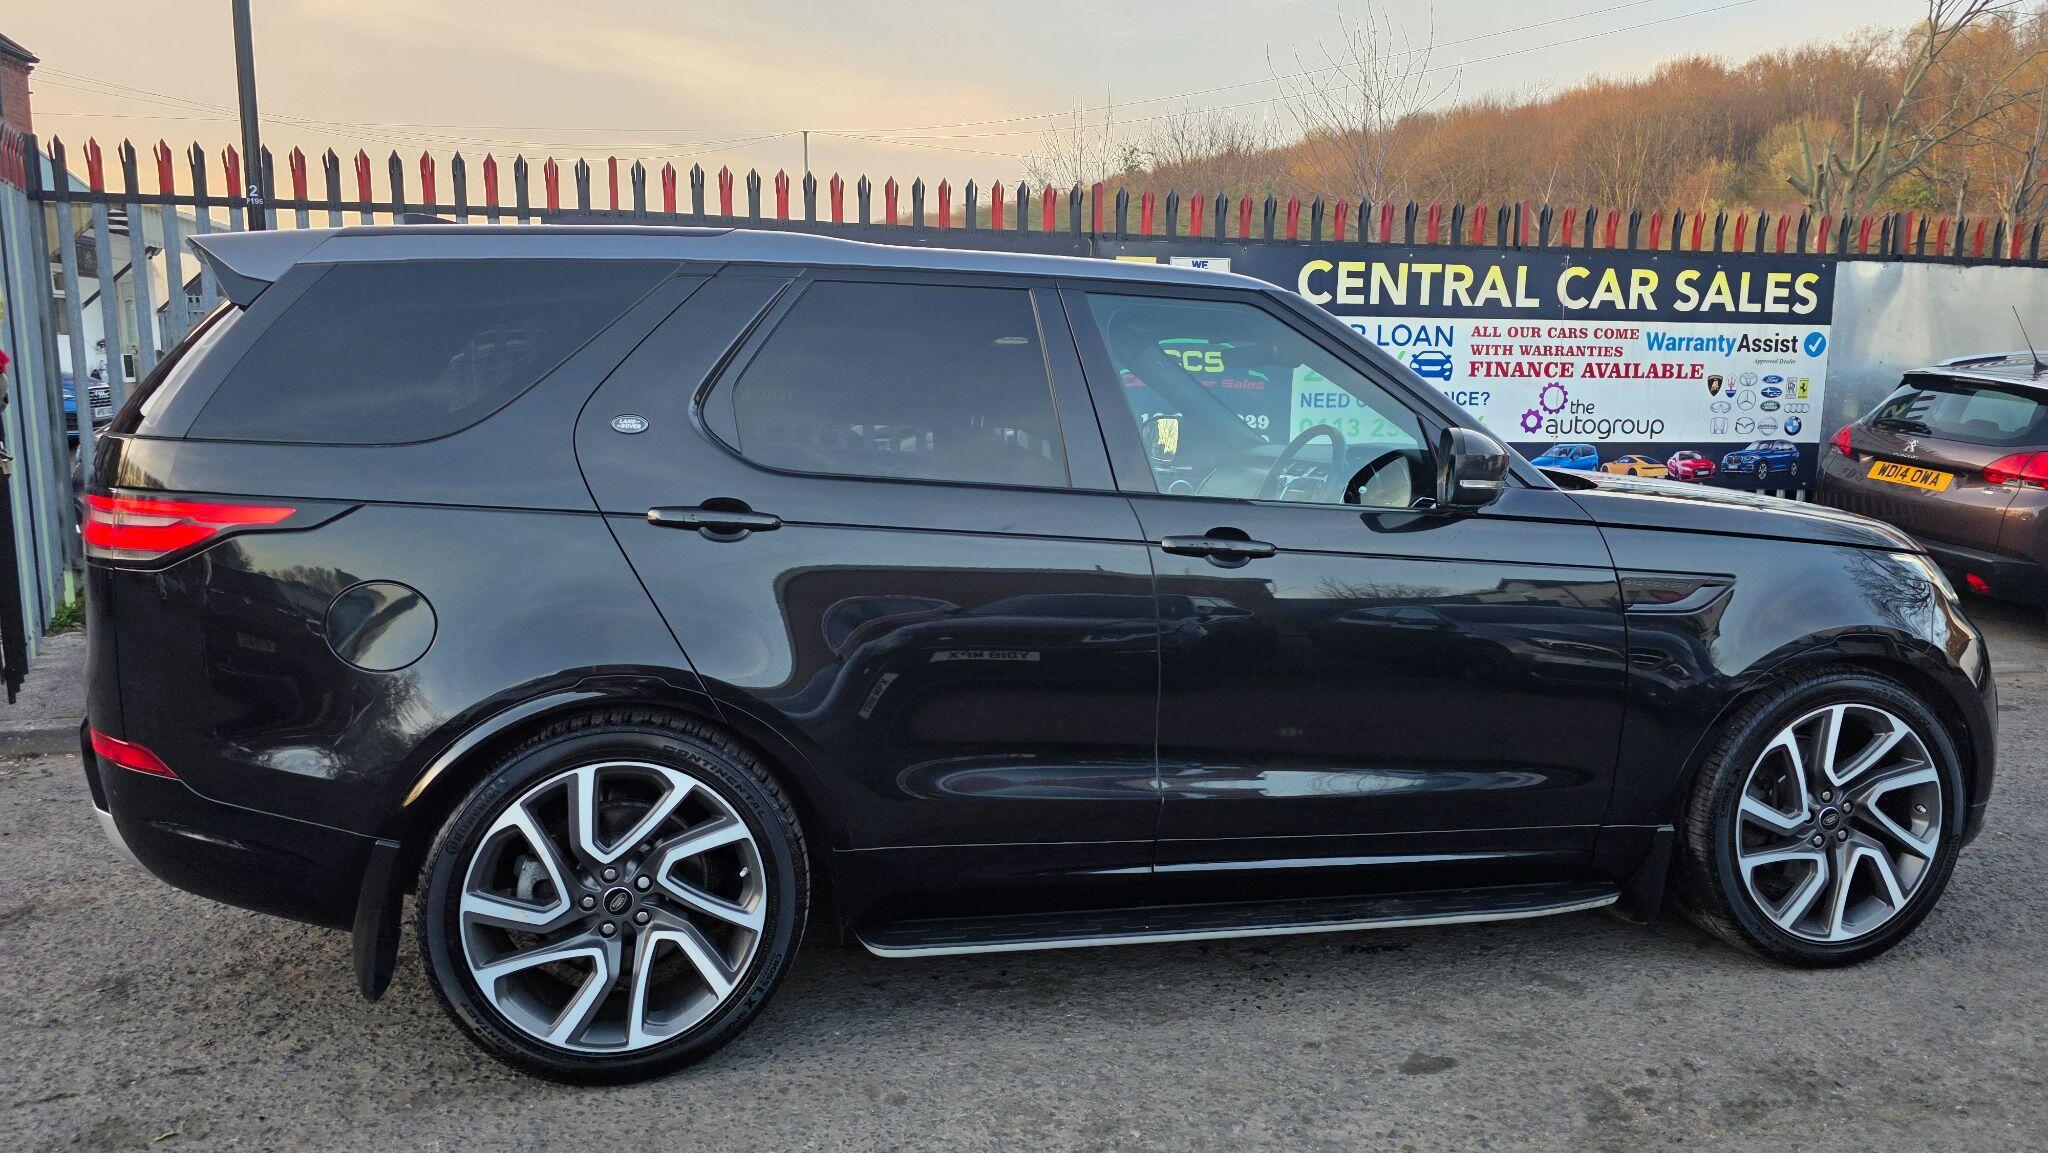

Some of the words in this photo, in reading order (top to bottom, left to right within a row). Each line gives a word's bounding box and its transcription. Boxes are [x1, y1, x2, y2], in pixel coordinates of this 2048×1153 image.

[249, 185, 259, 196] 2
[1297, 259, 1540, 308] CENTRAL
[1556, 266, 1659, 310] CAR
[1672, 269, 1820, 315] SALES
[1376, 322, 1454, 347] LOAN
[1470, 325, 1502, 338] ALL
[1507, 326, 1542, 339] OUR
[1547, 327, 1589, 339] CARS
[1593, 328, 1640, 340] COME
[1470, 344, 1514, 356] WITH
[1519, 345, 1624, 358] WARRANTIES
[1468, 361, 1575, 378] FINANCE
[1580, 363, 1705, 380] AVAILABLE
[1221, 378, 1265, 391] Sales
[1300, 392, 1350, 408] NEED
[1570, 399, 1595, 415] the
[1545, 416, 1665, 439] autogroup
[1877, 463, 1909, 480] WD14
[1911, 471, 1940, 487] OWA
[662, 745, 766, 818] CONTINENTAL
